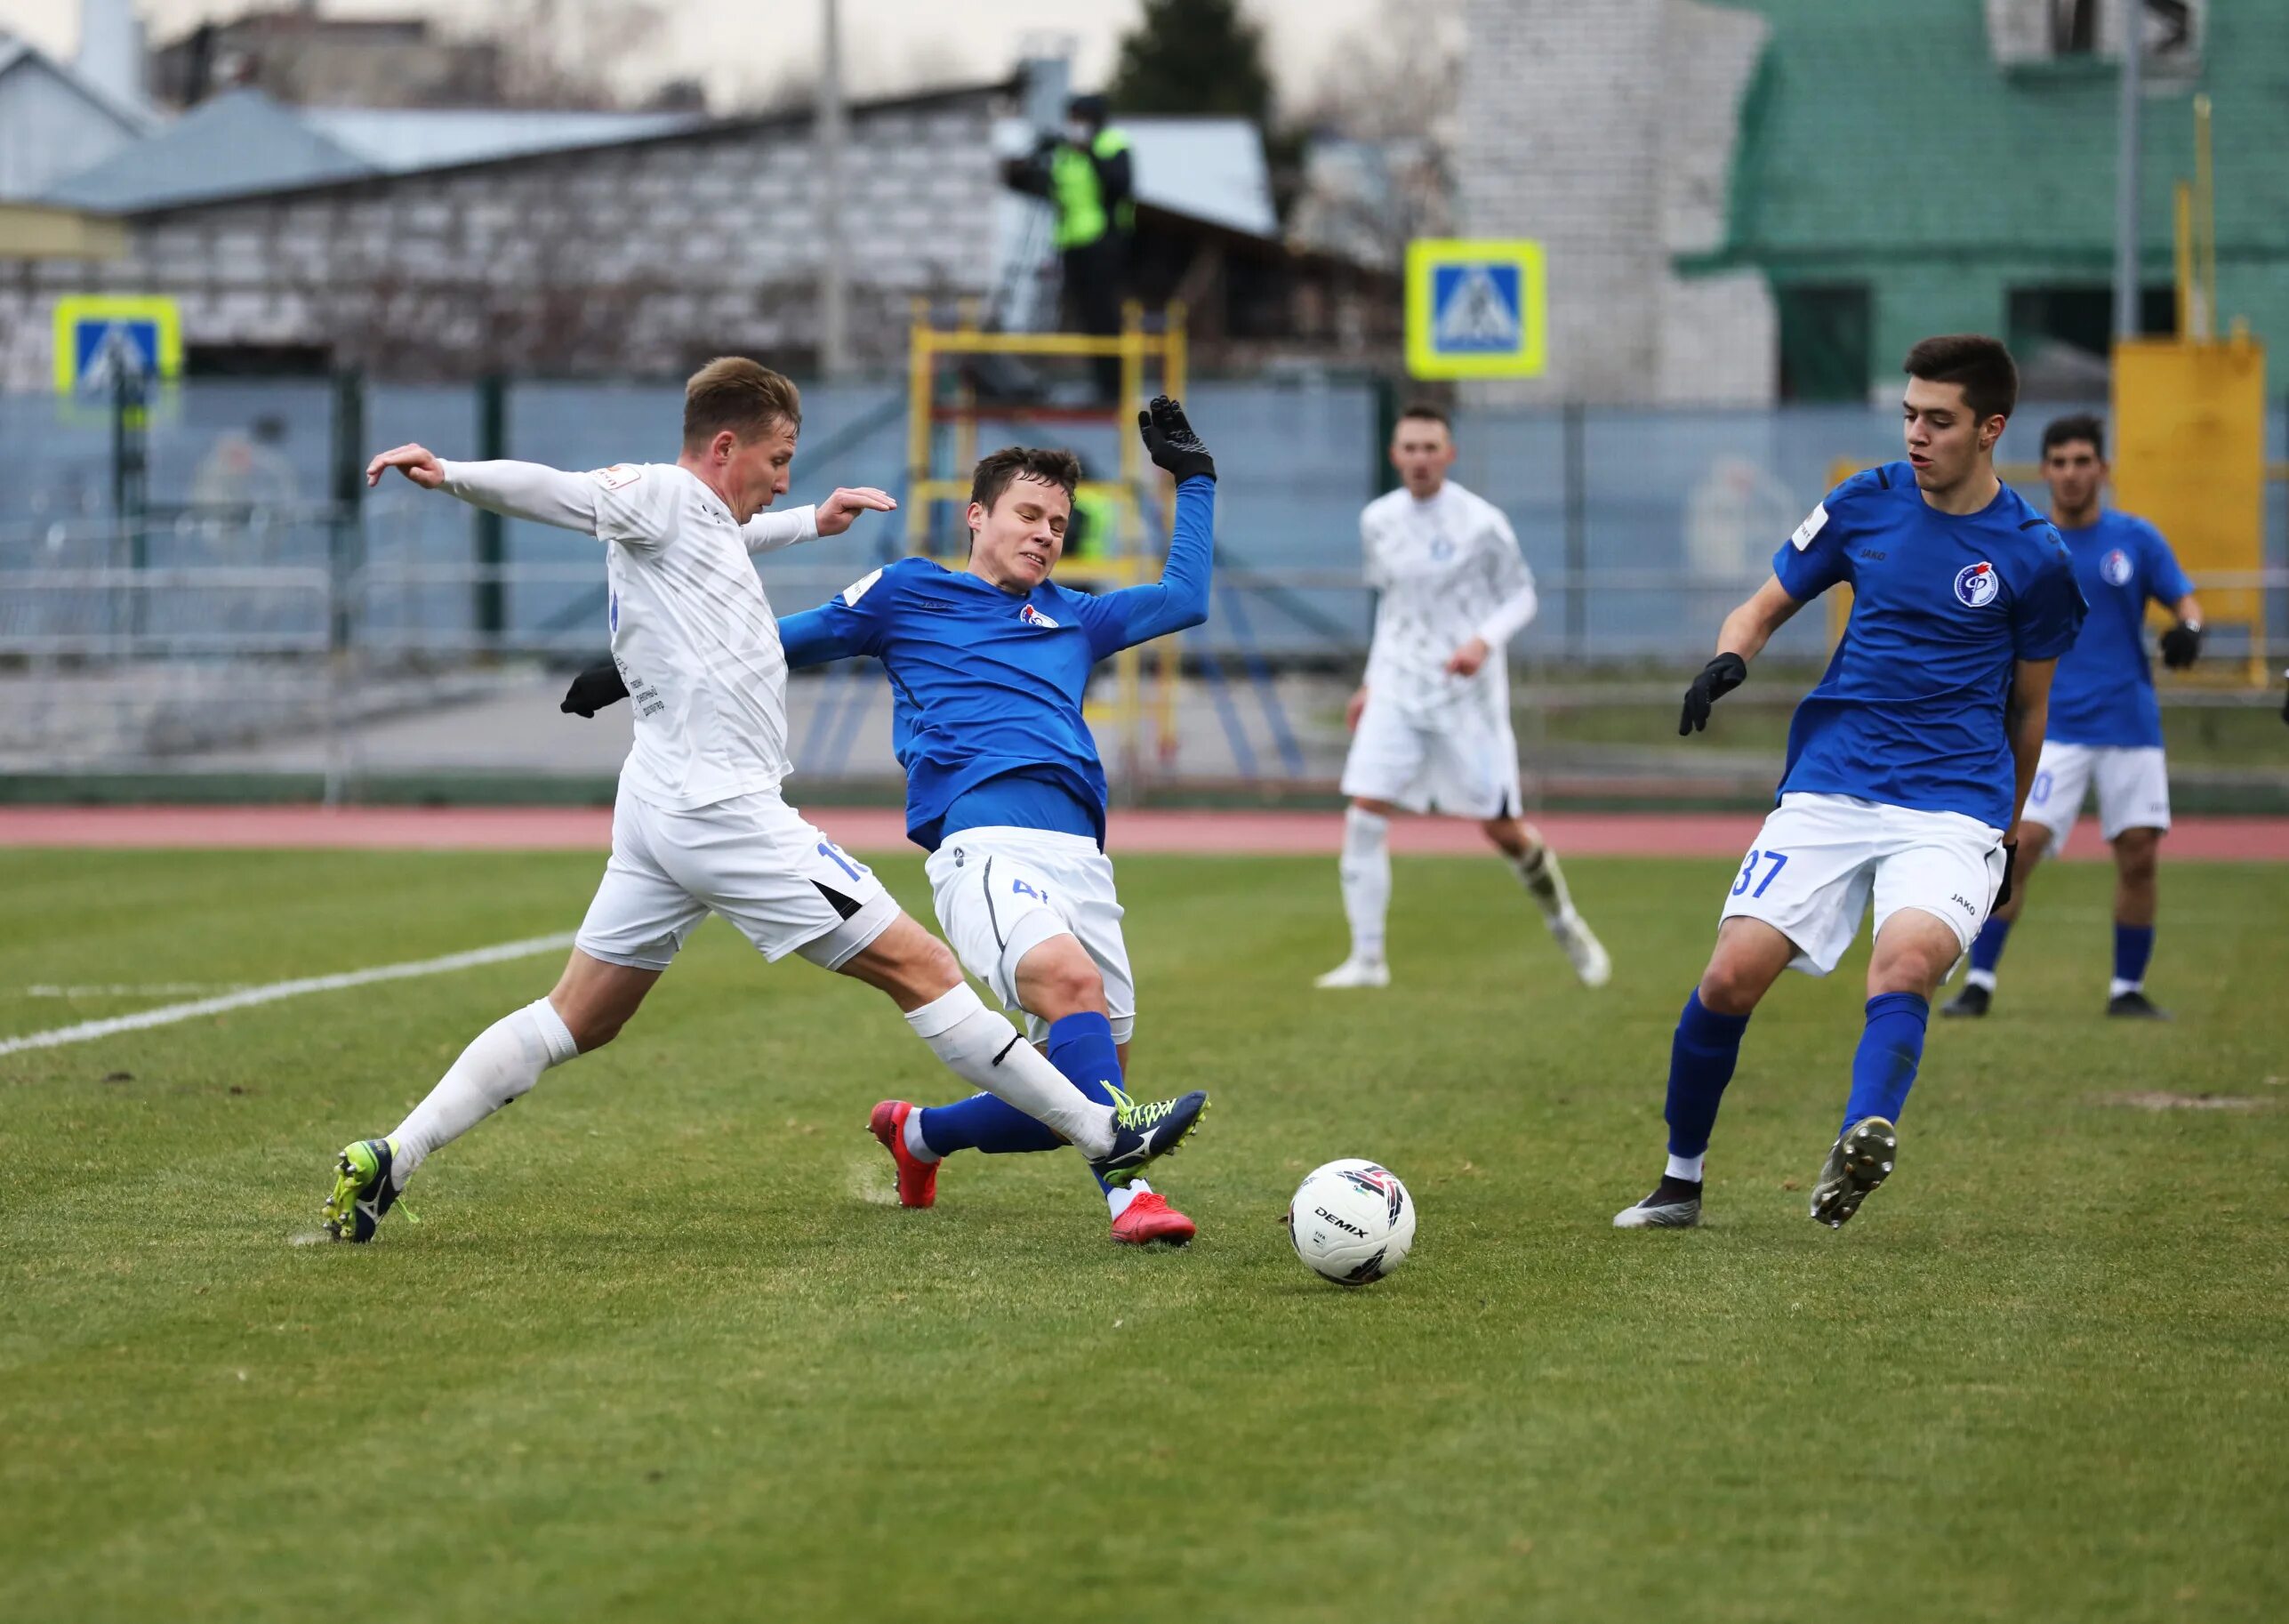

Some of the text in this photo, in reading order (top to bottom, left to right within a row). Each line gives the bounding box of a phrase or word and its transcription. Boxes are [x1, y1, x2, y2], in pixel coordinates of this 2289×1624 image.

[1859, 548, 1886, 561] JAKO
[1731, 848, 1788, 898] 37
[1950, 892, 1976, 916] JAKO
[1314, 1206, 1369, 1239] DEMIX
[1314, 1231, 1326, 1241] FIFA
